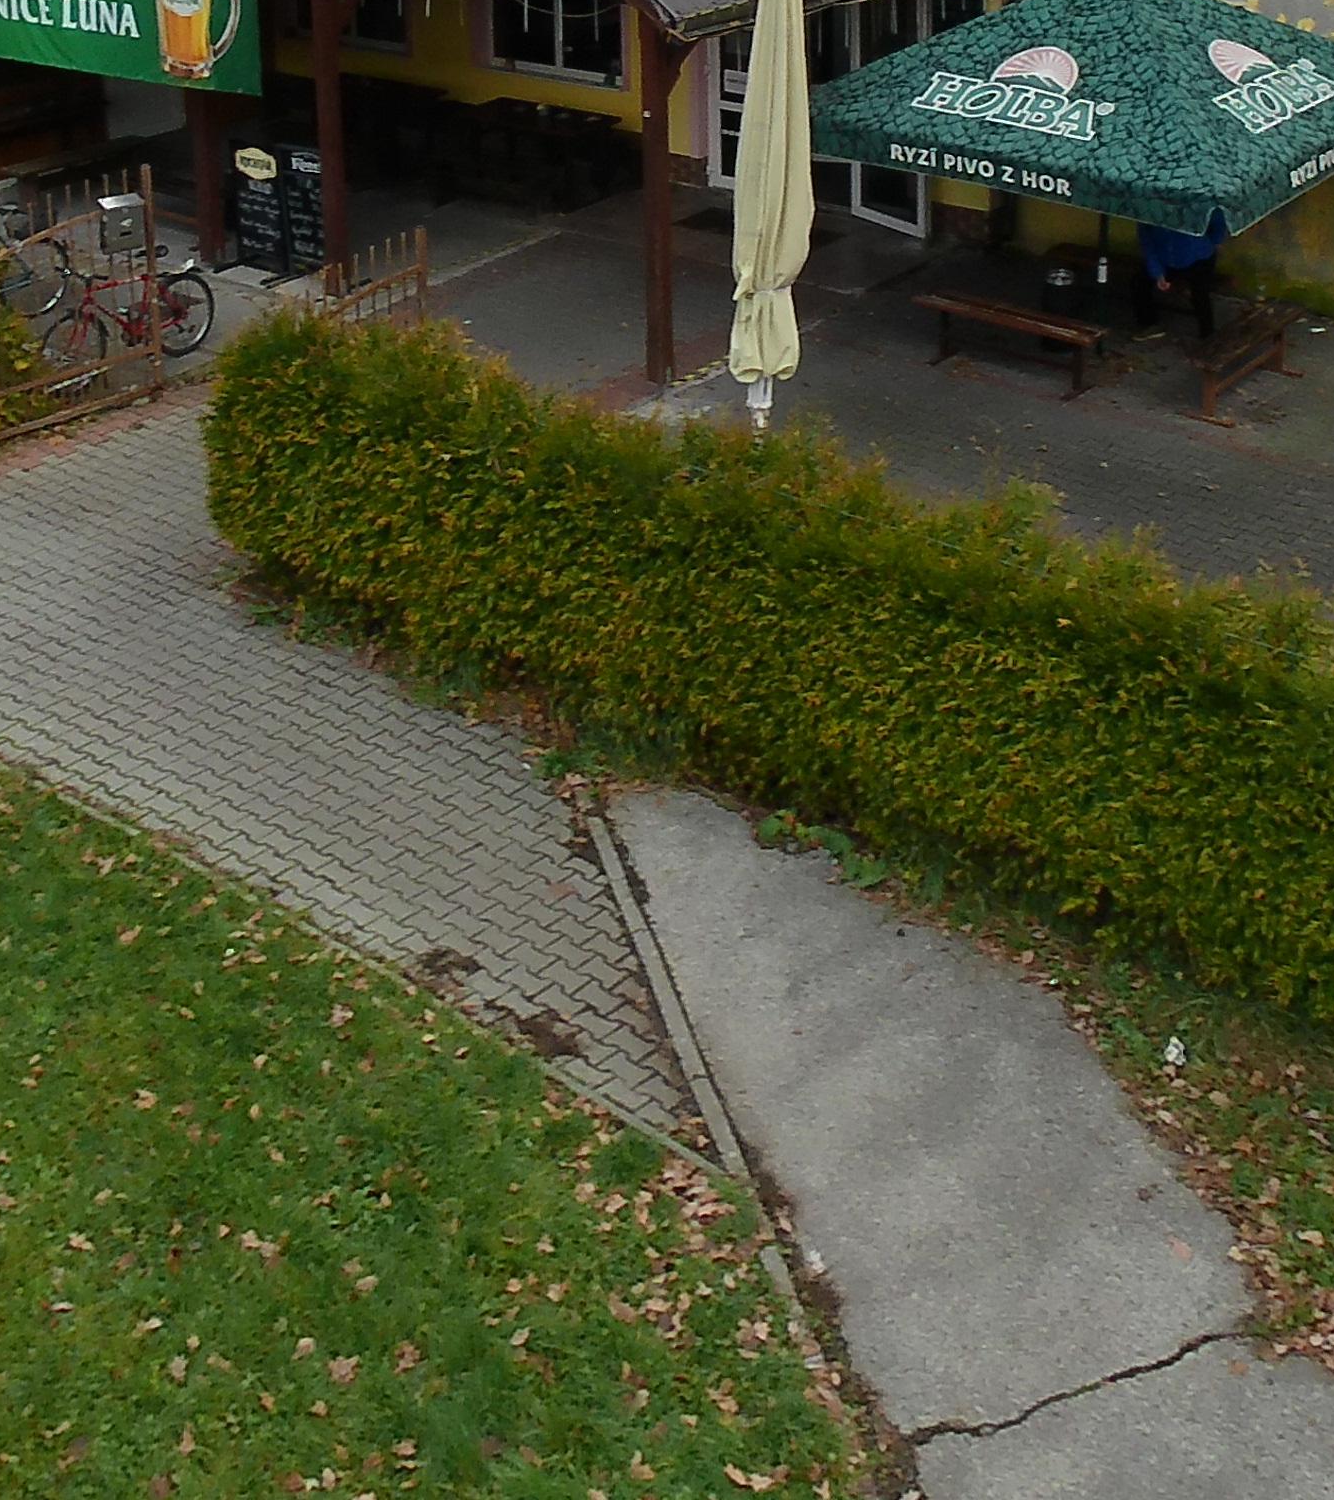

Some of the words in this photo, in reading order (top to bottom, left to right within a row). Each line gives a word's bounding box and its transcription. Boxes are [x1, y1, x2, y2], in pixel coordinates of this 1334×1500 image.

[911, 71, 1097, 142] HOLBA
[889, 143, 938, 168] RYZÍ
[943, 153, 996, 178] PIVO
[1000, 165, 1016, 183] Z
[1021, 170, 1073, 197] HOR
